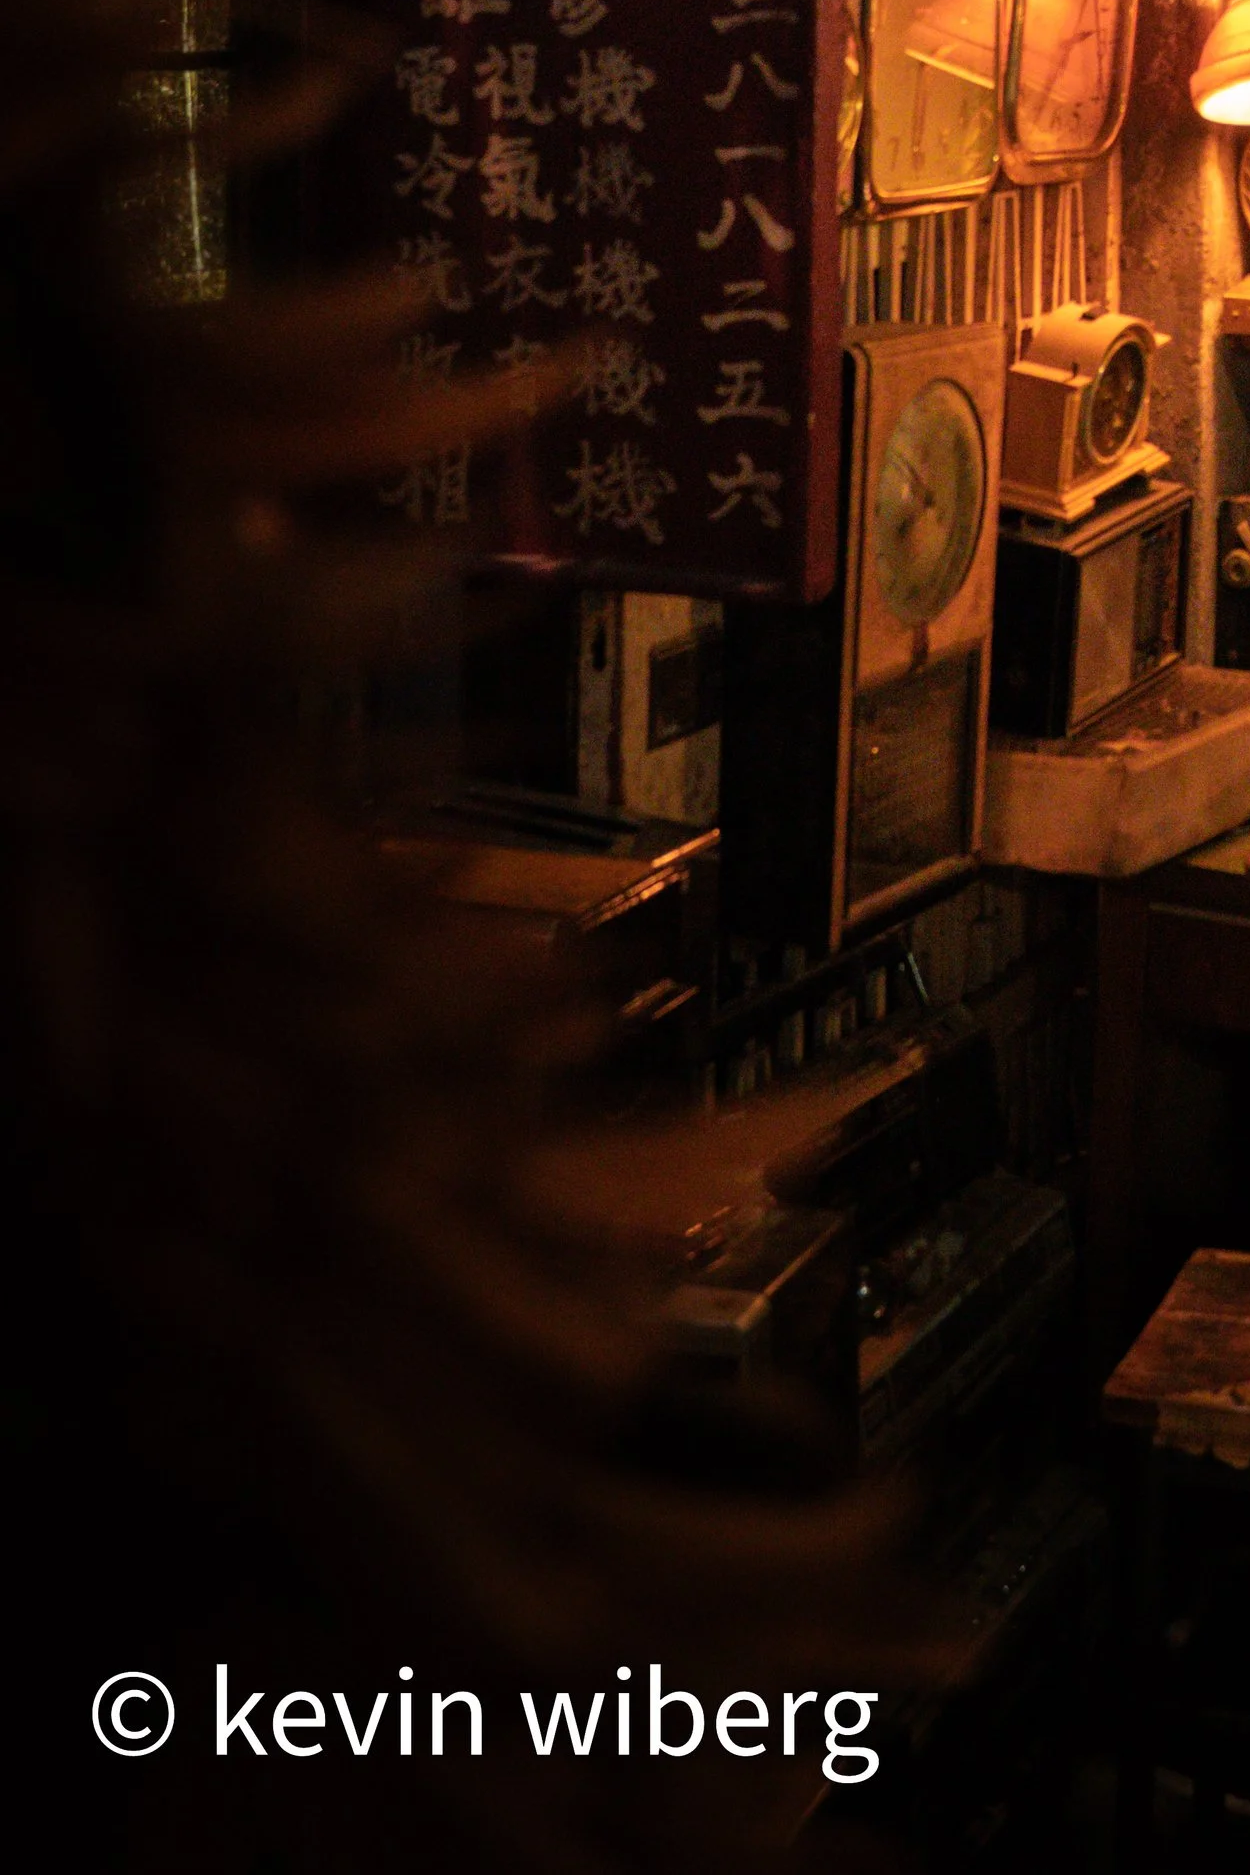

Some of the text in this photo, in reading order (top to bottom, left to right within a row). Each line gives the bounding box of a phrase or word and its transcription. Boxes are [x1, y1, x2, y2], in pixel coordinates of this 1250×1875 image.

[396, 43, 657, 133] 電視機
[394, 134, 657, 228] 冷氣機
[397, 237, 662, 326] 洗衣機
